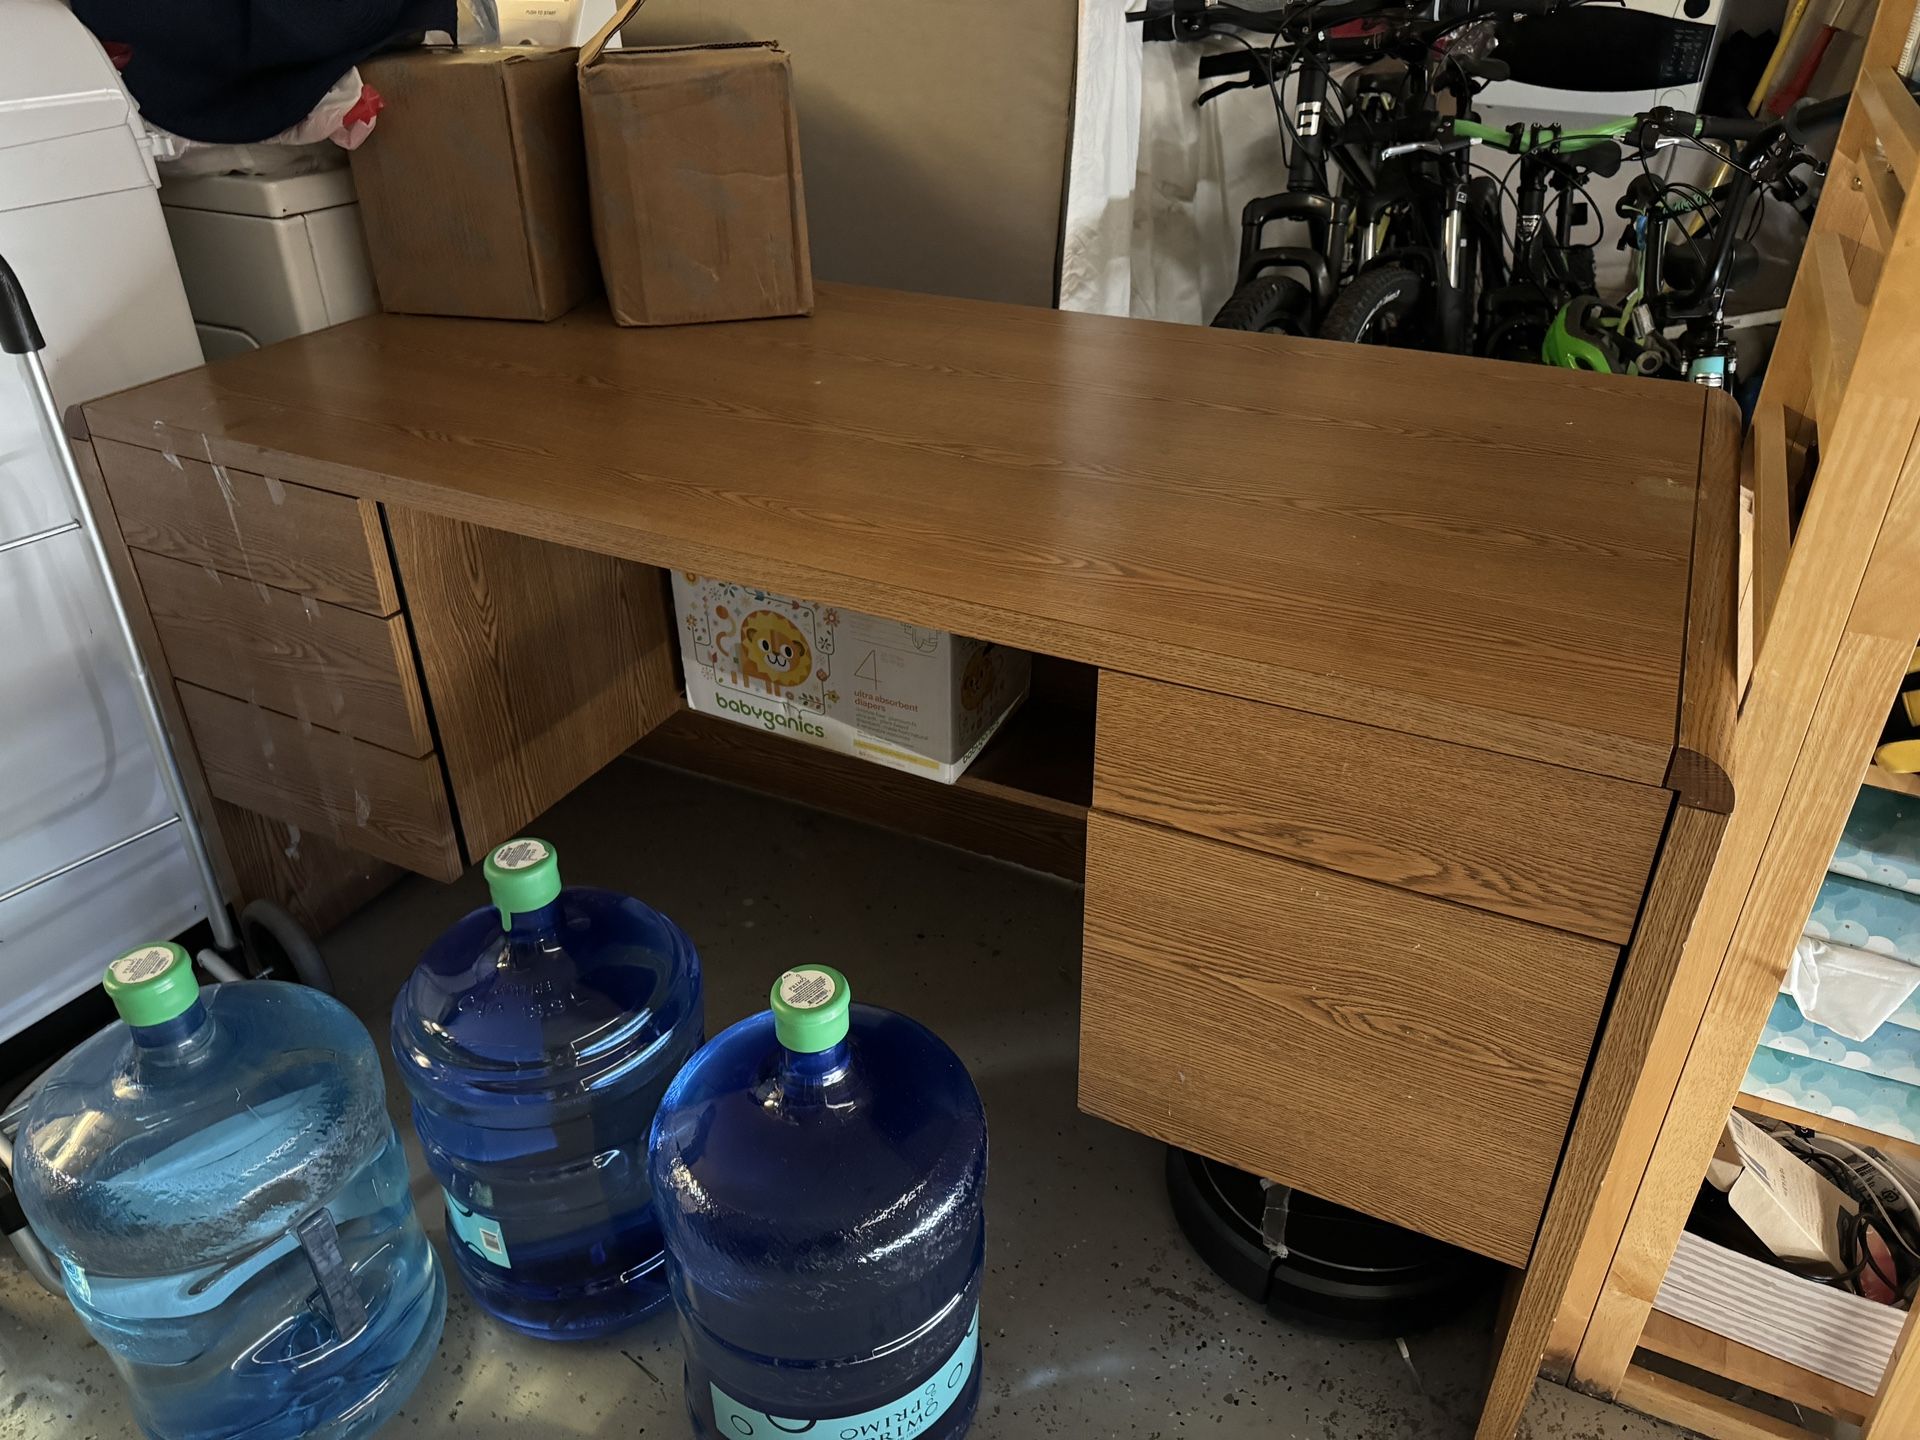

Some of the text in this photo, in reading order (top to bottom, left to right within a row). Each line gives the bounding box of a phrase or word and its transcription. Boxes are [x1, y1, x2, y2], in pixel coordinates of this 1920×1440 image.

[854, 649, 883, 691] 4
[715, 692, 825, 739] babyganics
[854, 689, 919, 713] ultra absorbent
[854, 698, 887, 713] diapers
[840, 1400, 920, 1440] PRIMO
[864, 1401, 939, 1440] RIMO
